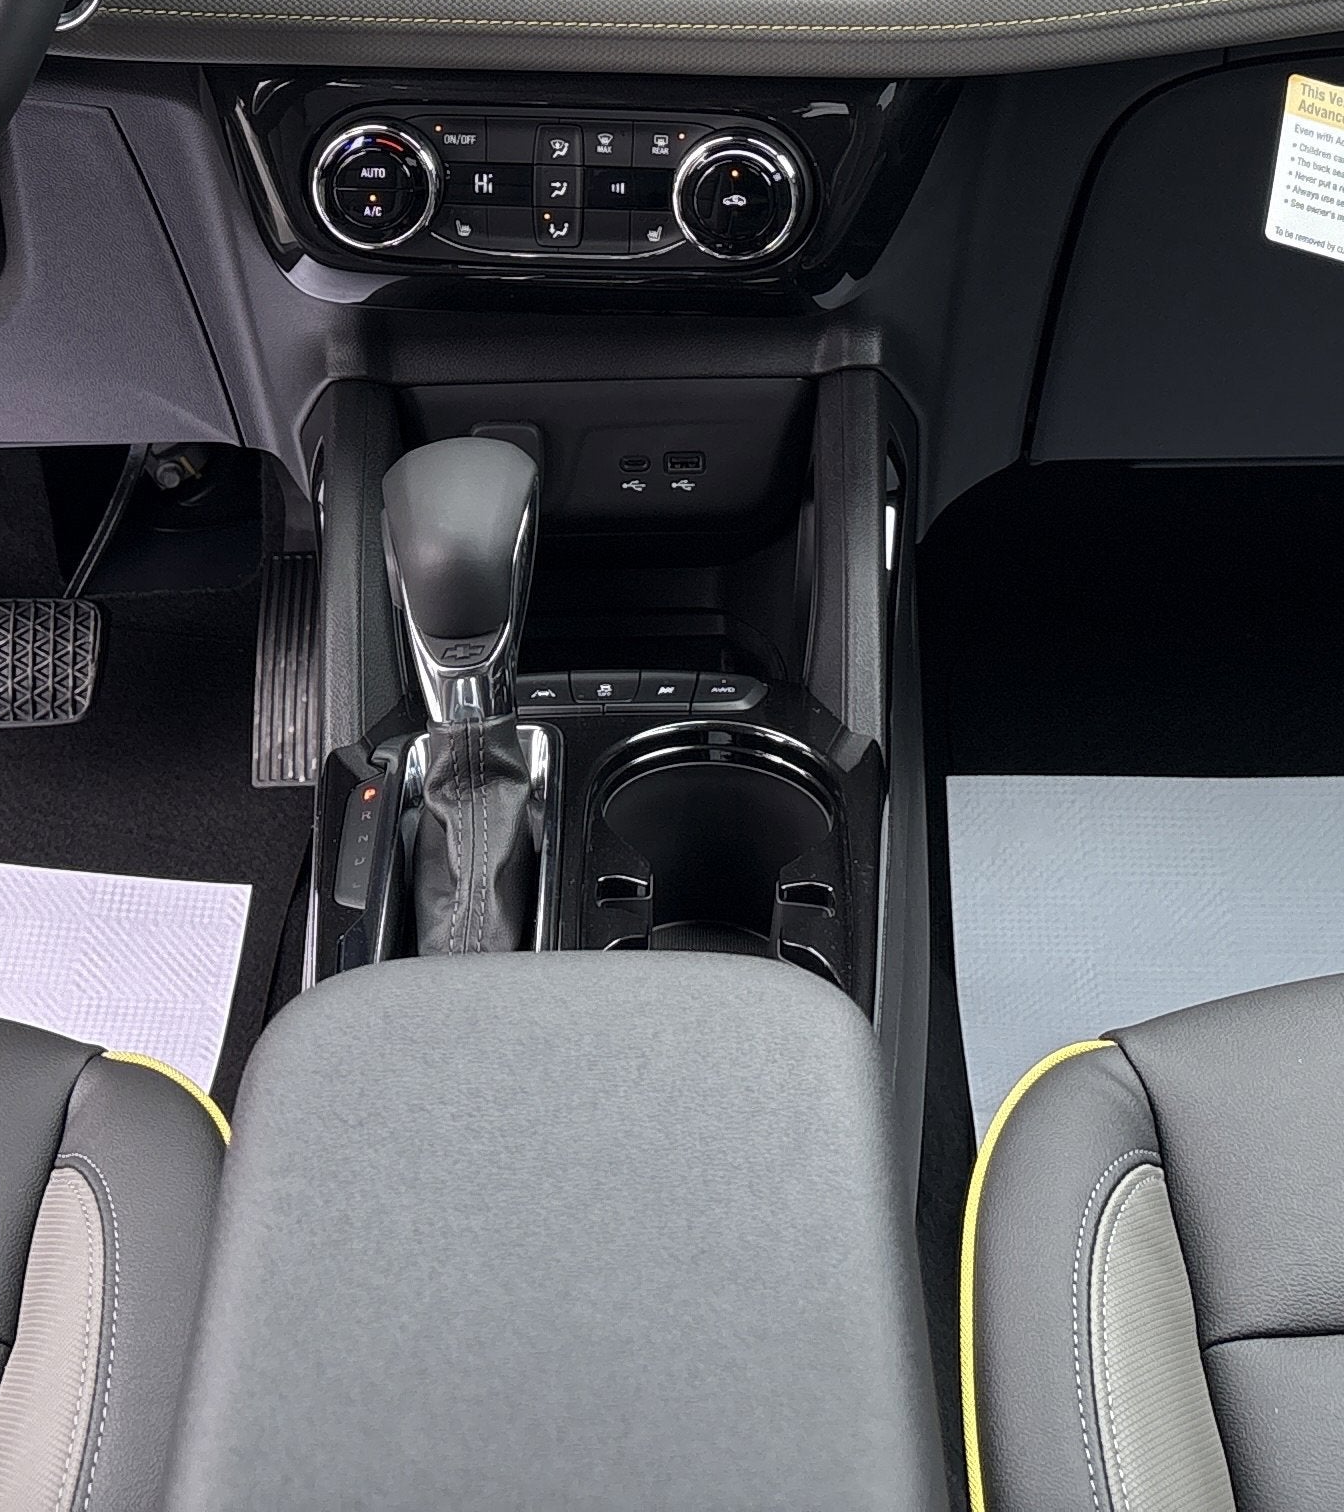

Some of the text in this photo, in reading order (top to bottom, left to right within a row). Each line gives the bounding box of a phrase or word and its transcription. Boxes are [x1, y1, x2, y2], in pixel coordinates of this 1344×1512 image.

[1300, 82, 1326, 102] This
[443, 133, 477, 146] ON/OFF
[1294, 123, 1315, 137] Even
[1316, 131, 1334, 144] with
[596, 144, 613, 154] MAX
[651, 145, 670, 156] REAR
[1299, 143, 1332, 160] Children
[360, 166, 387, 179] AUTO
[1297, 156, 1311, 169] The
[1312, 161, 1331, 174] back
[1295, 171, 1318, 184] Never
[1318, 179, 1332, 189] put
[1292, 184, 1320, 201] Always
[1320, 194, 1335, 205] use
[363, 206, 383, 218] A/C
[1290, 198, 1305, 210] See
[1306, 204, 1336, 220] owner's
[1275, 225, 1284, 236] To
[1284, 228, 1294, 239] be
[1295, 233, 1326, 249] removed
[1326, 241, 1337, 253] by
[363, 788, 376, 801] P
[361, 810, 372, 821] R
